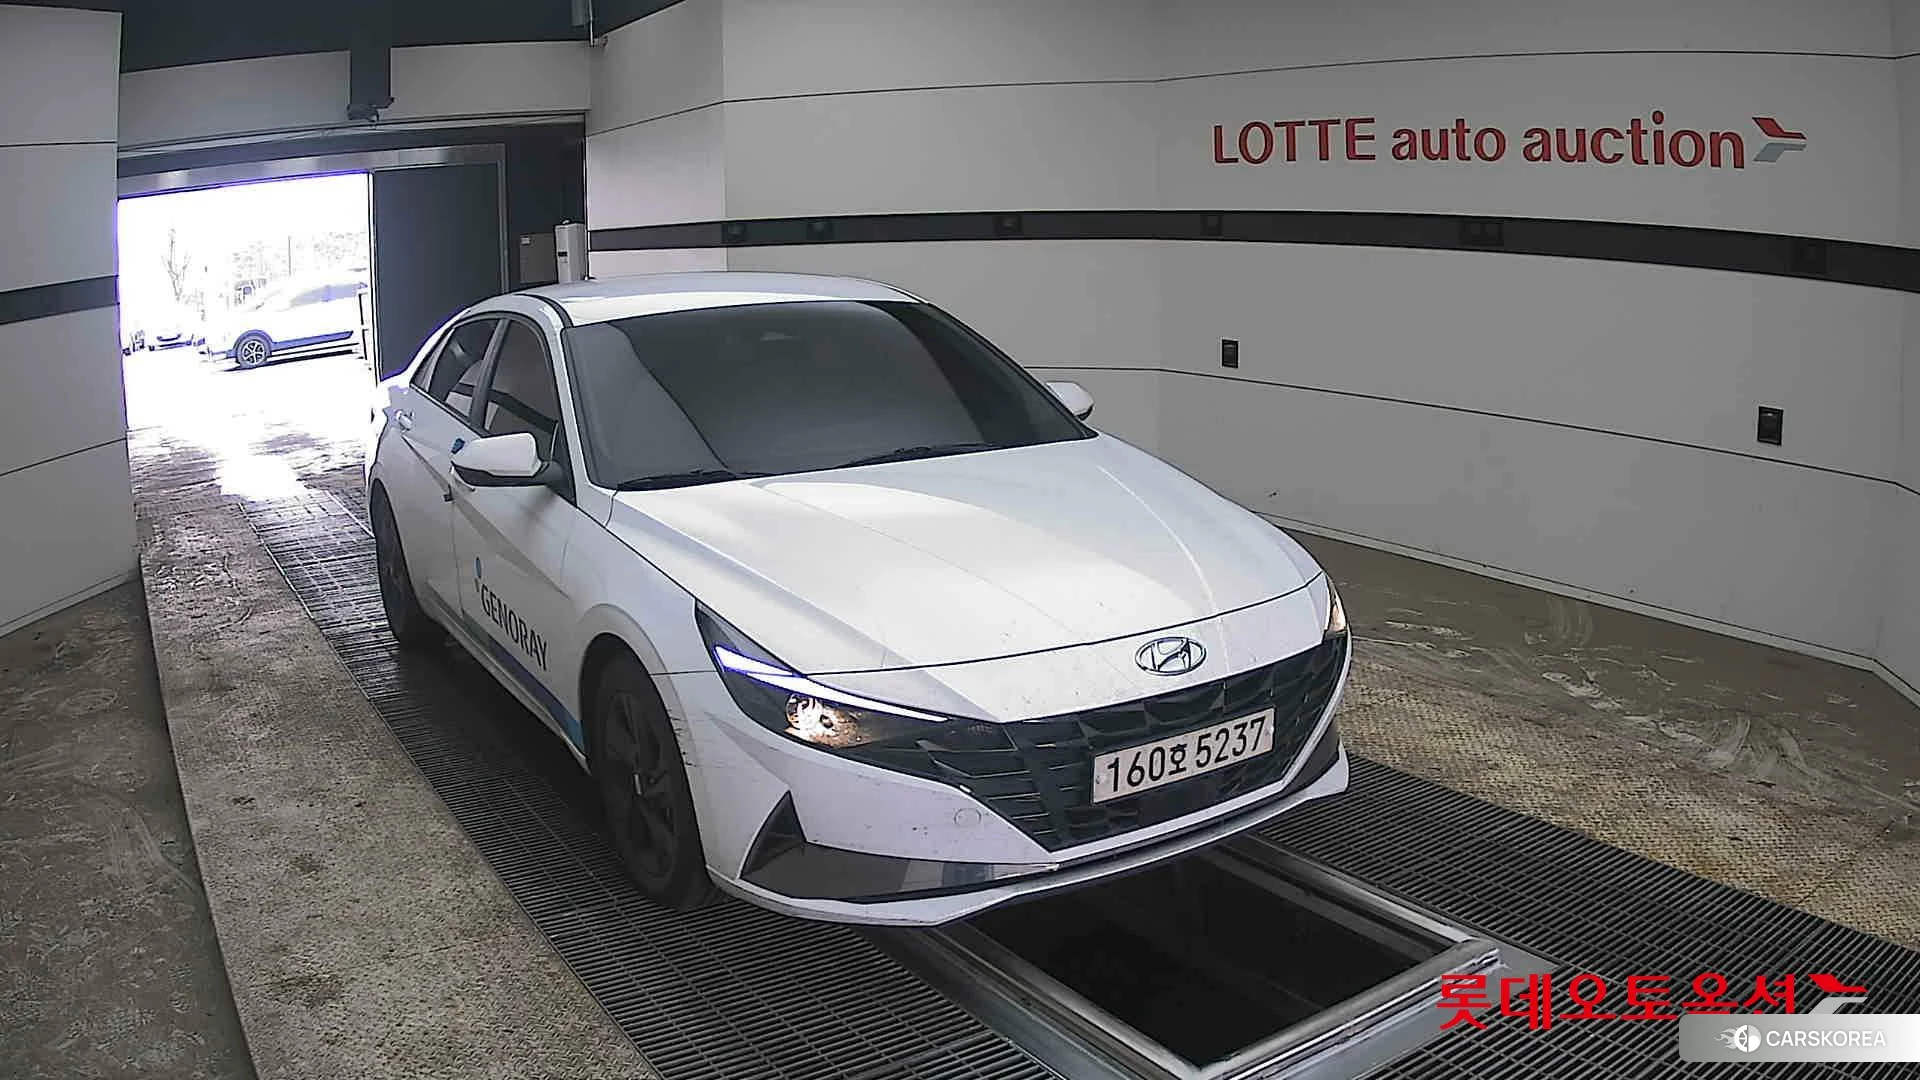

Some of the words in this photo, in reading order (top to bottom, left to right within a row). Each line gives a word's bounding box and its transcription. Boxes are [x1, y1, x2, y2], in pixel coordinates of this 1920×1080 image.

[1212, 117, 1376, 164] LOTTE
[1391, 117, 1506, 162] auto
[1522, 110, 1746, 169] auction
[480, 583, 547, 672] GENORAY
[1195, 715, 1267, 768] 5237
